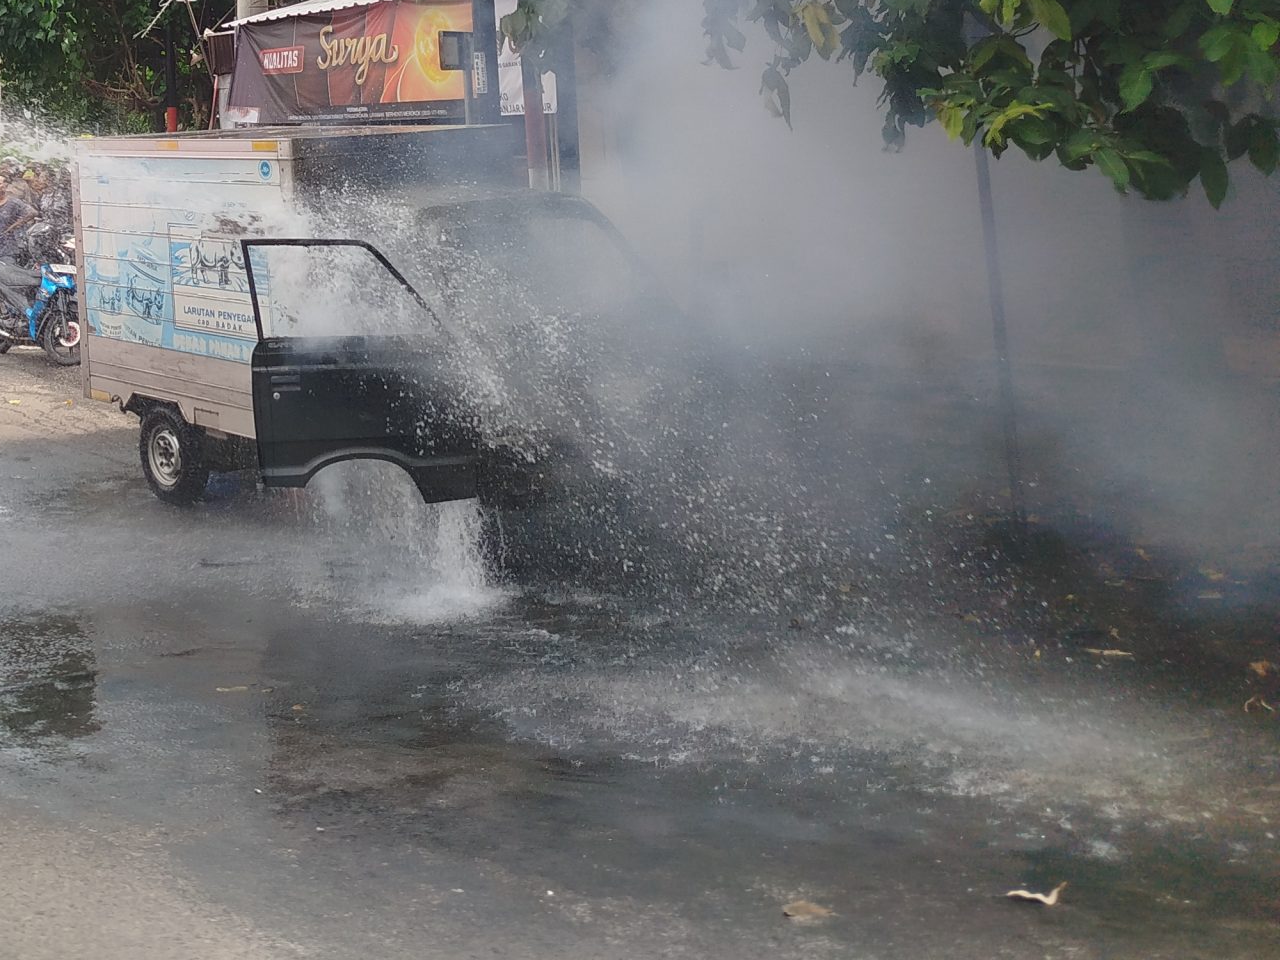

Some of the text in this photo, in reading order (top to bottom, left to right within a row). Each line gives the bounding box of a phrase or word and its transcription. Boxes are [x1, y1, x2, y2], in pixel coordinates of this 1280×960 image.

[316, 24, 400, 86] Surya
[183, 305, 215, 318] LARUTAN
[216, 321, 244, 332] BADAK
